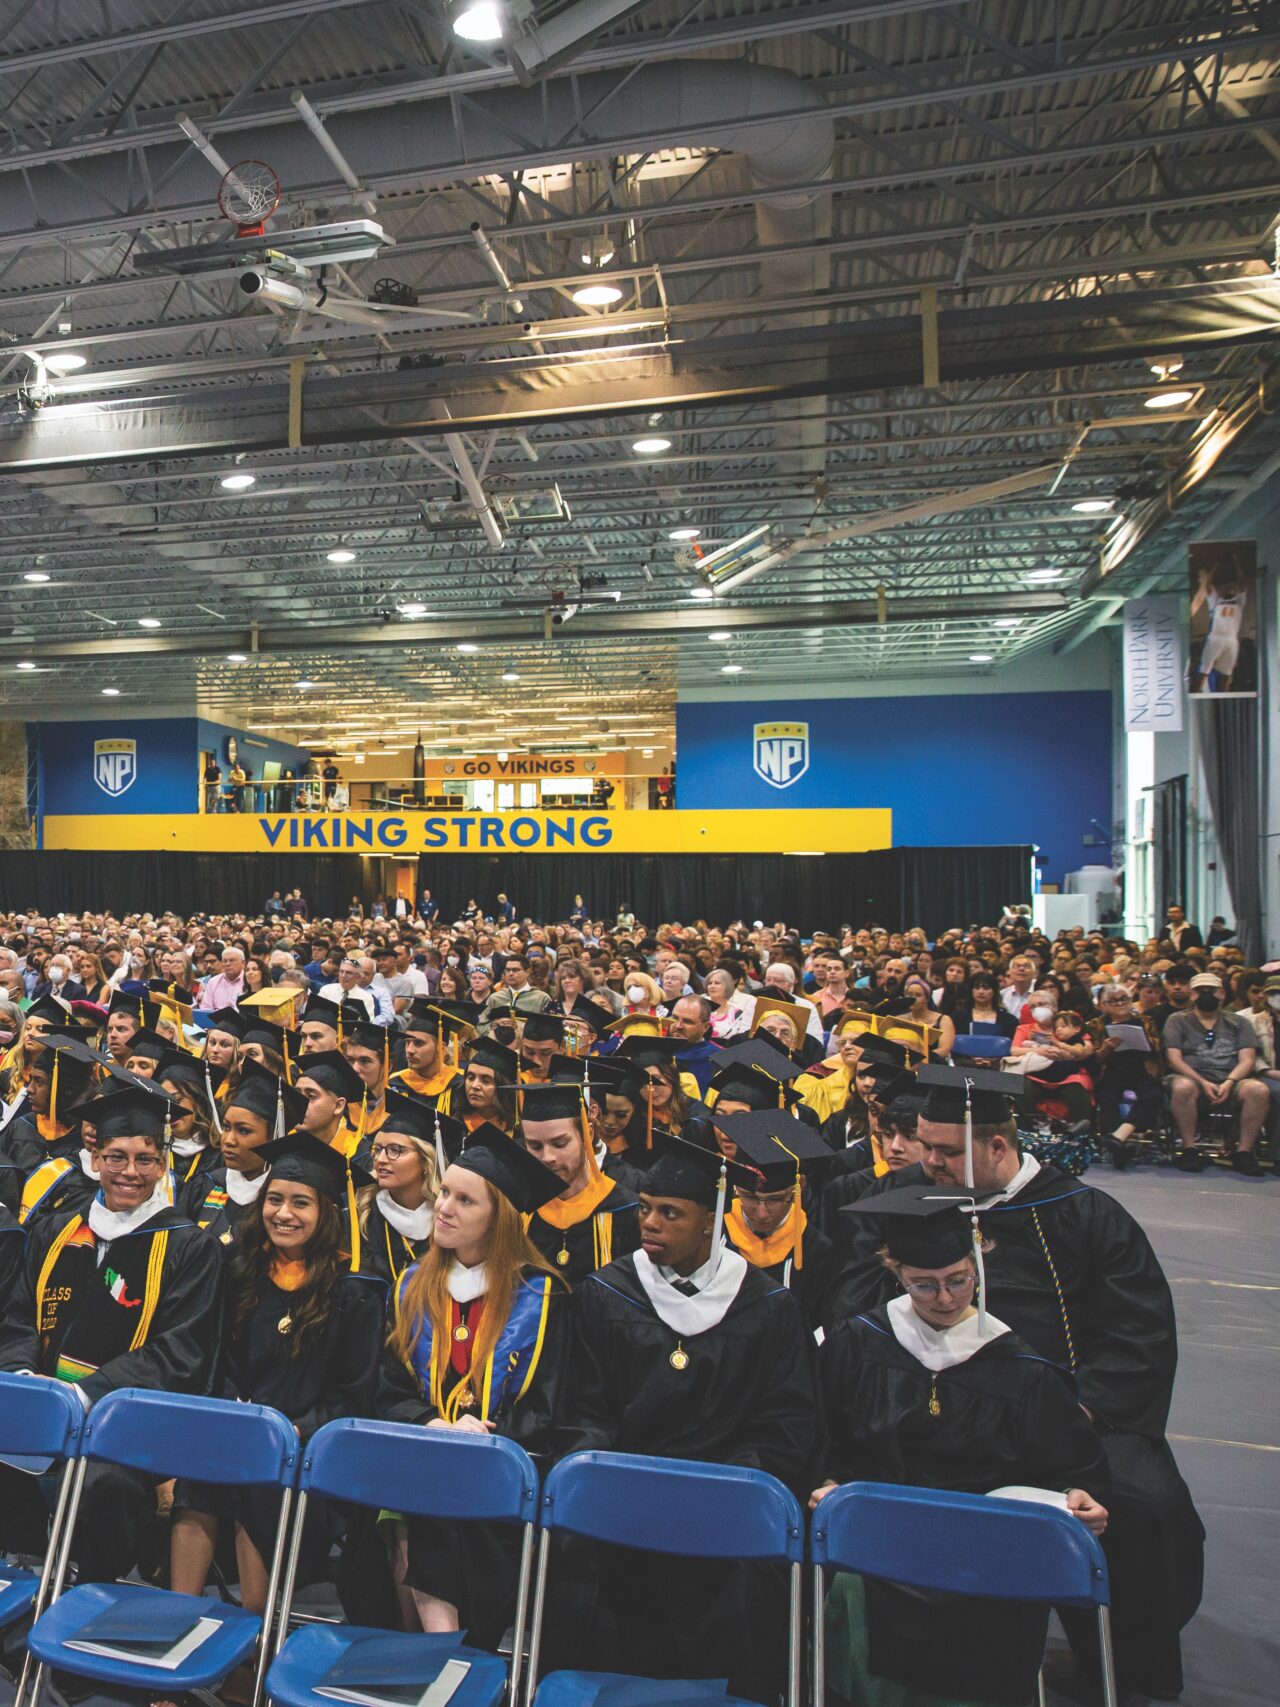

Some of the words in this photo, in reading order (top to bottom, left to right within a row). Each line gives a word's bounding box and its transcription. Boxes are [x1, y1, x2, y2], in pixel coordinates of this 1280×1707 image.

[1129, 606, 1150, 653] PARK
[1154, 612, 1175, 718] UNIVERSITY
[1130, 657, 1150, 724] NORTH
[98, 754, 132, 791] NP
[463, 761, 491, 775] GO
[497, 760, 575, 774] VIKINGS
[759, 740, 803, 782] NP
[258, 818, 408, 847] VIKING
[424, 817, 613, 847] STRONG
[47, 1303, 58, 1315] OF
